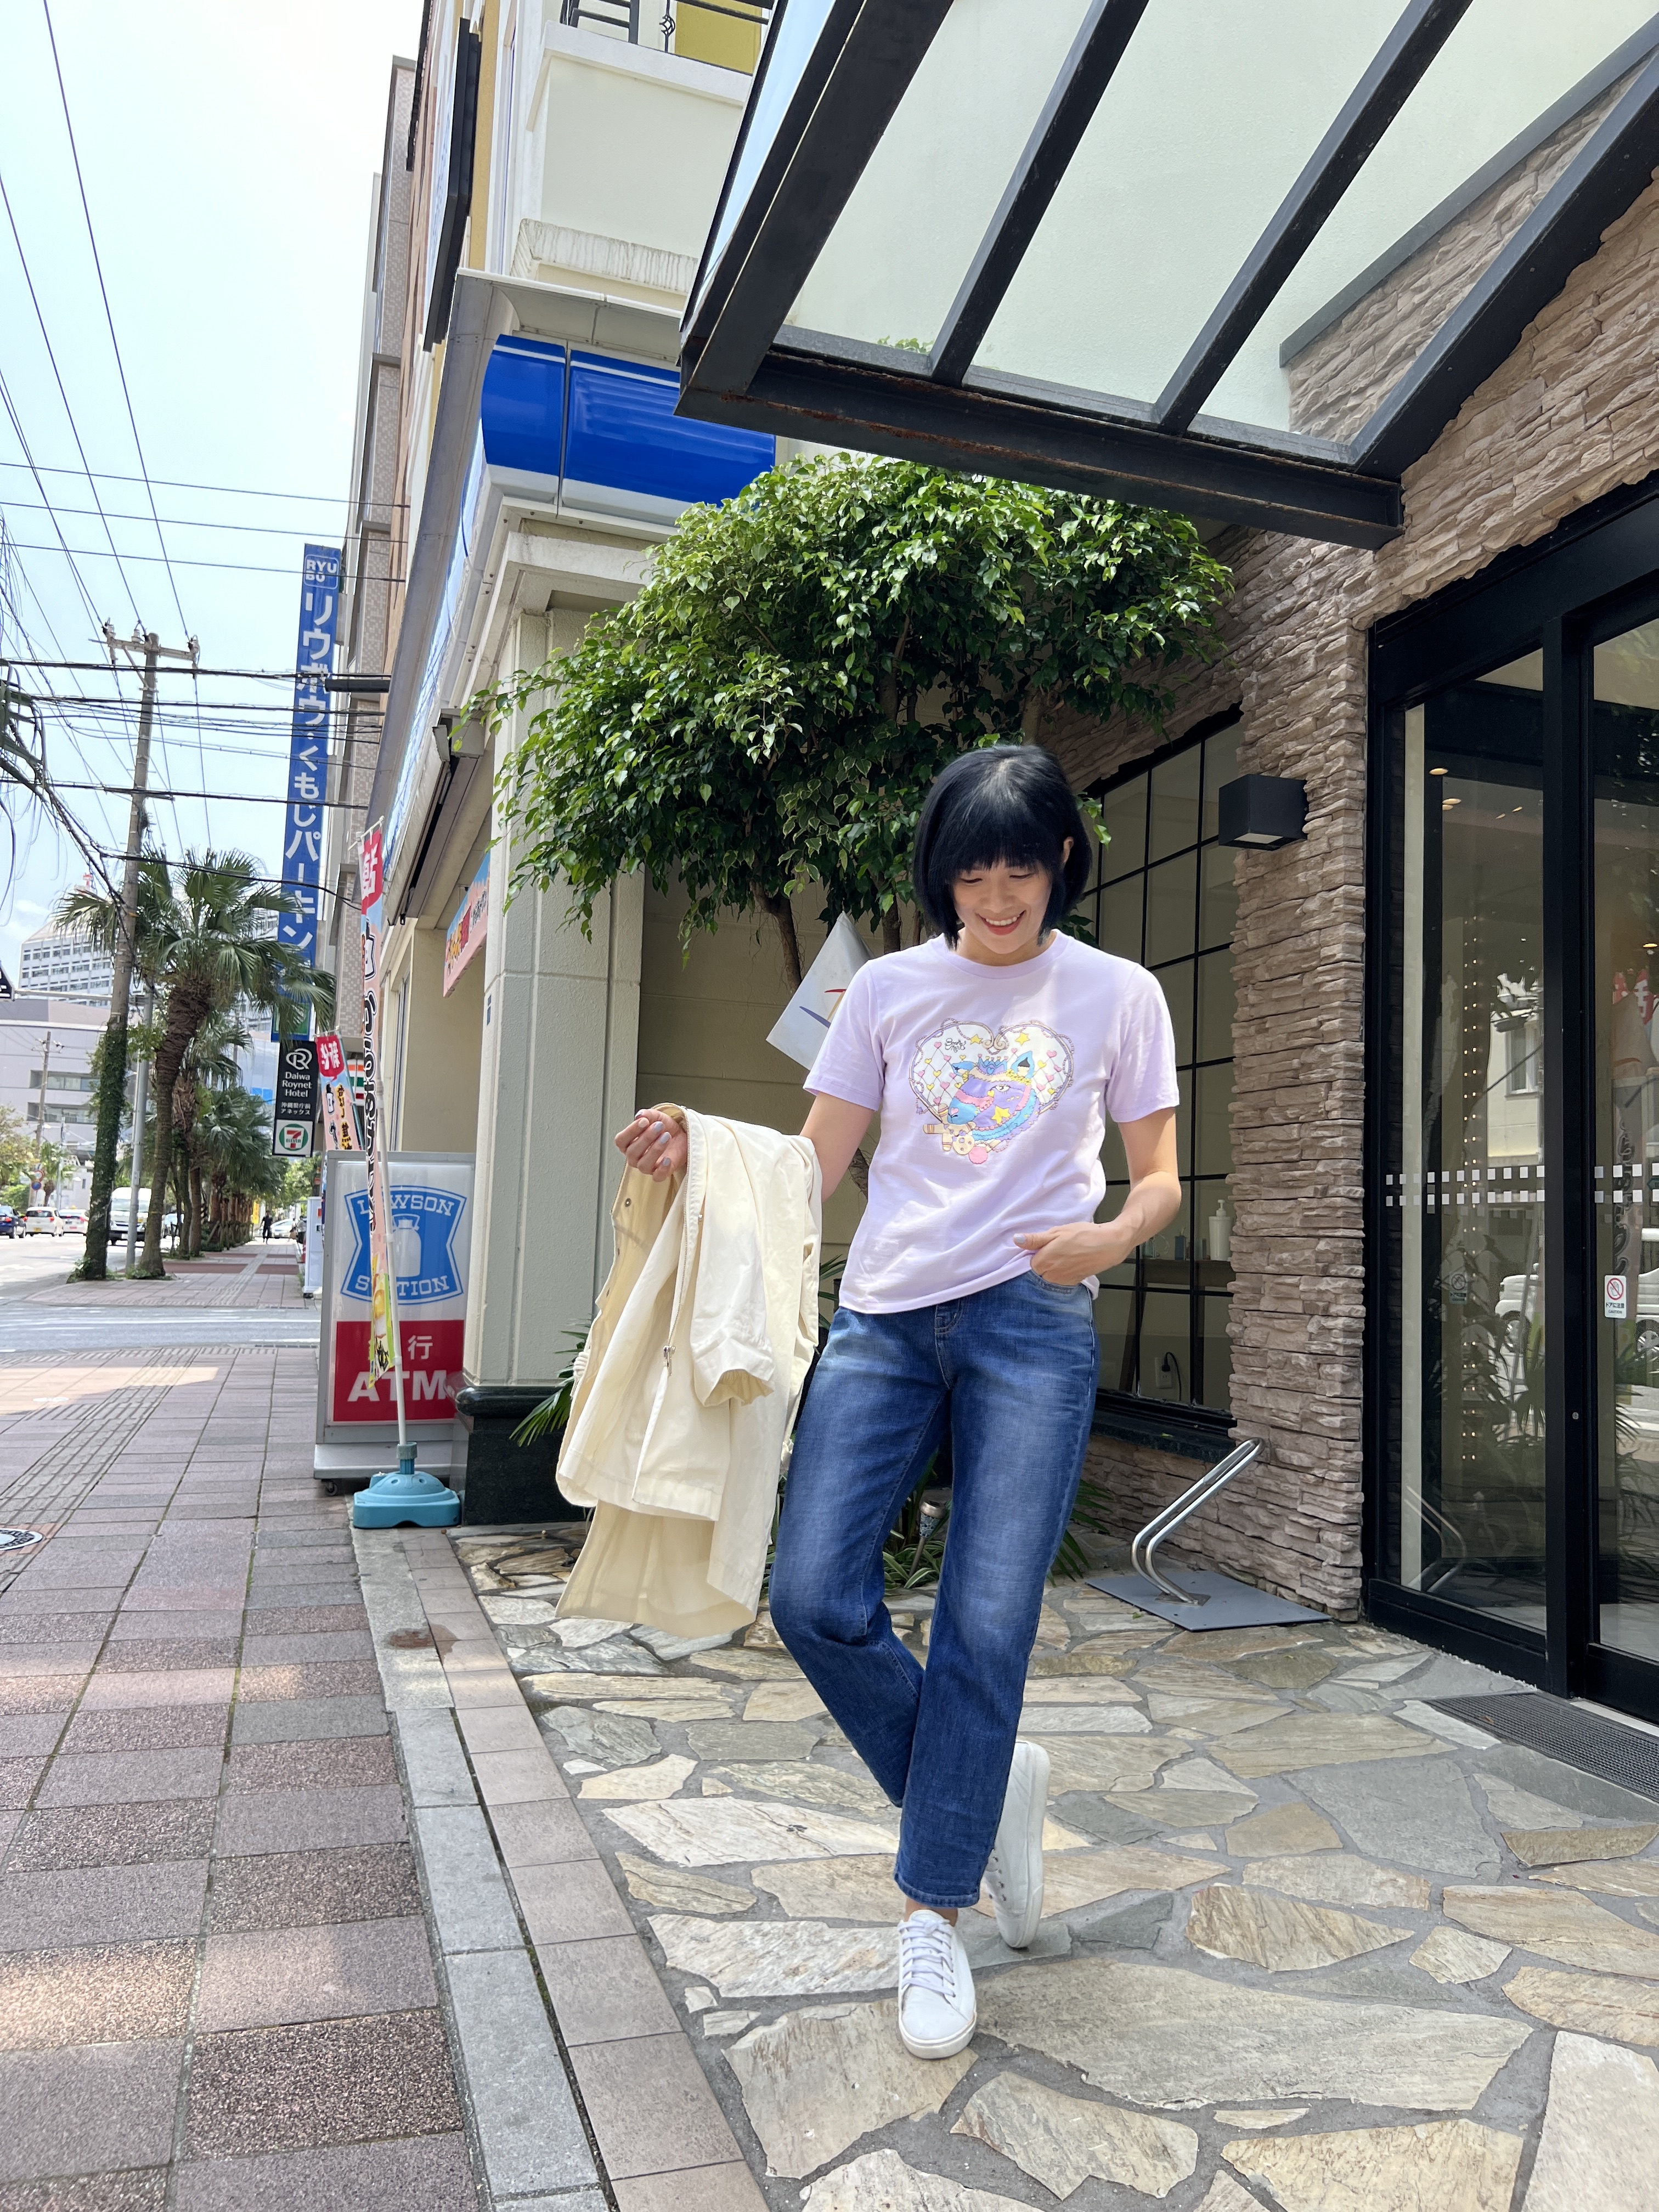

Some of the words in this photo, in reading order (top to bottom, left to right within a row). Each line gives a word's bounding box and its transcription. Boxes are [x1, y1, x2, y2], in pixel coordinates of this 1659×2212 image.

[306, 559, 337, 574] RYU
[278, 593, 332, 991] リウボウ・くもじパーキン
[285, 1071, 311, 1080] Daiwa
[282, 1080, 313, 1090] Roynet
[285, 1089, 308, 1097] Hotel
[357, 1194, 454, 1216] LWSON
[355, 1274, 450, 1296] STION
[347, 1370, 447, 1402] ATM
